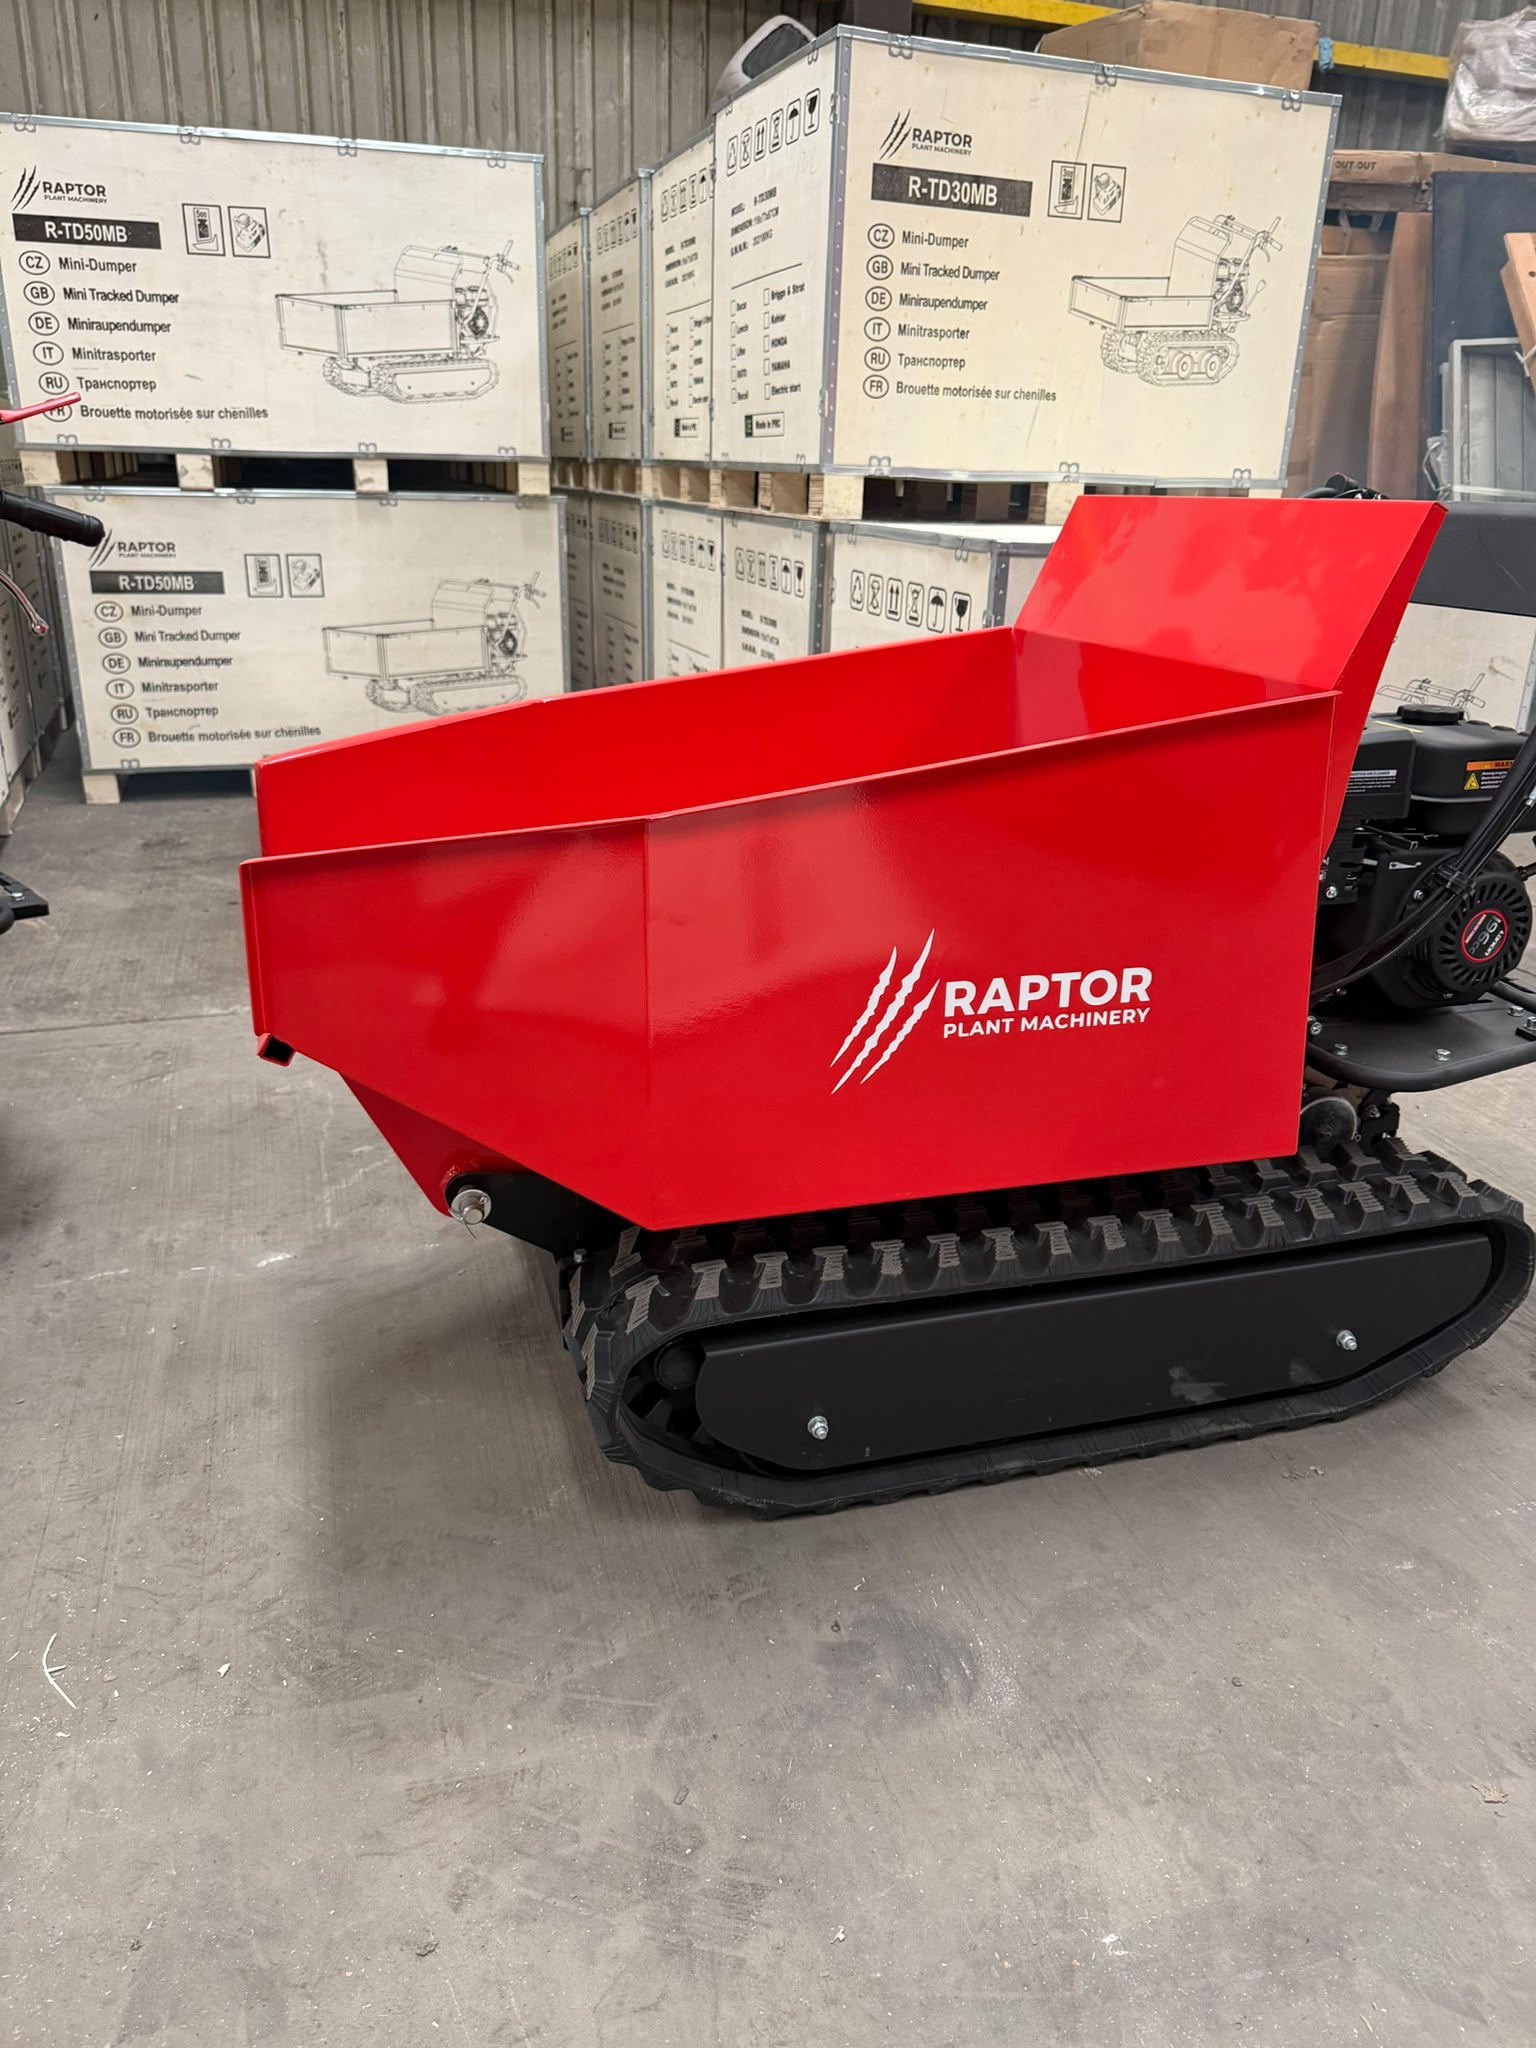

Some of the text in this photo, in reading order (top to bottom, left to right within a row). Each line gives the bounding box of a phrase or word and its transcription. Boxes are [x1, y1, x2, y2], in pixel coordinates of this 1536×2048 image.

[912, 127, 973, 149] RAPTOR
[912, 144, 972, 156] PLANT MACHINERY
[42, 181, 107, 197] RAPTOR
[908, 175, 998, 207] R-TD30MB
[68, 195, 108, 204] MACHINERY
[44, 221, 128, 243] R-TD50MB
[874, 229, 969, 250] CZ Mini-Dumper
[26, 256, 137, 275] CZ Mini-Dumper
[872, 260, 1000, 283] GB Mini Tracked Dumper
[30, 286, 180, 306] GB Mini Tracked Dumper
[872, 291, 988, 312] DE Miniraupendumper
[35, 316, 171, 335] DE Miniraupendumper
[872, 322, 970, 341] IT Minitrasporter
[42, 346, 156, 364] IT Minitrasporter
[870, 352, 886, 365] RU
[898, 352, 966, 371] Транспортер
[46, 376, 63, 390] RU
[77, 376, 157, 393] Транспортер
[870, 379, 1056, 401] FR Brouette motorisée sur chenilles
[81, 405, 132, 419] Brouette
[135, 405, 193, 420] motorisée
[196, 407, 215, 419] sur
[218, 407, 268, 420] chenilles
[118, 541, 176, 553] RAPTOR
[118, 576, 194, 591] R-TD50MB
[101, 605, 202, 618] CZ Mini-Dumper
[105, 630, 241, 644] GB Mini Tracked Dumper
[108, 656, 232, 669] DE Miniraupendumper
[115, 682, 219, 695] IT Minitrasporter
[117, 708, 133, 720] RU
[146, 706, 219, 719] Транспортер
[120, 726, 321, 743] FR Brouette motorisée sur chenilles
[944, 966, 1153, 1018] RAPTOR
[944, 1007, 1151, 1039] PLANT MACHINERY
